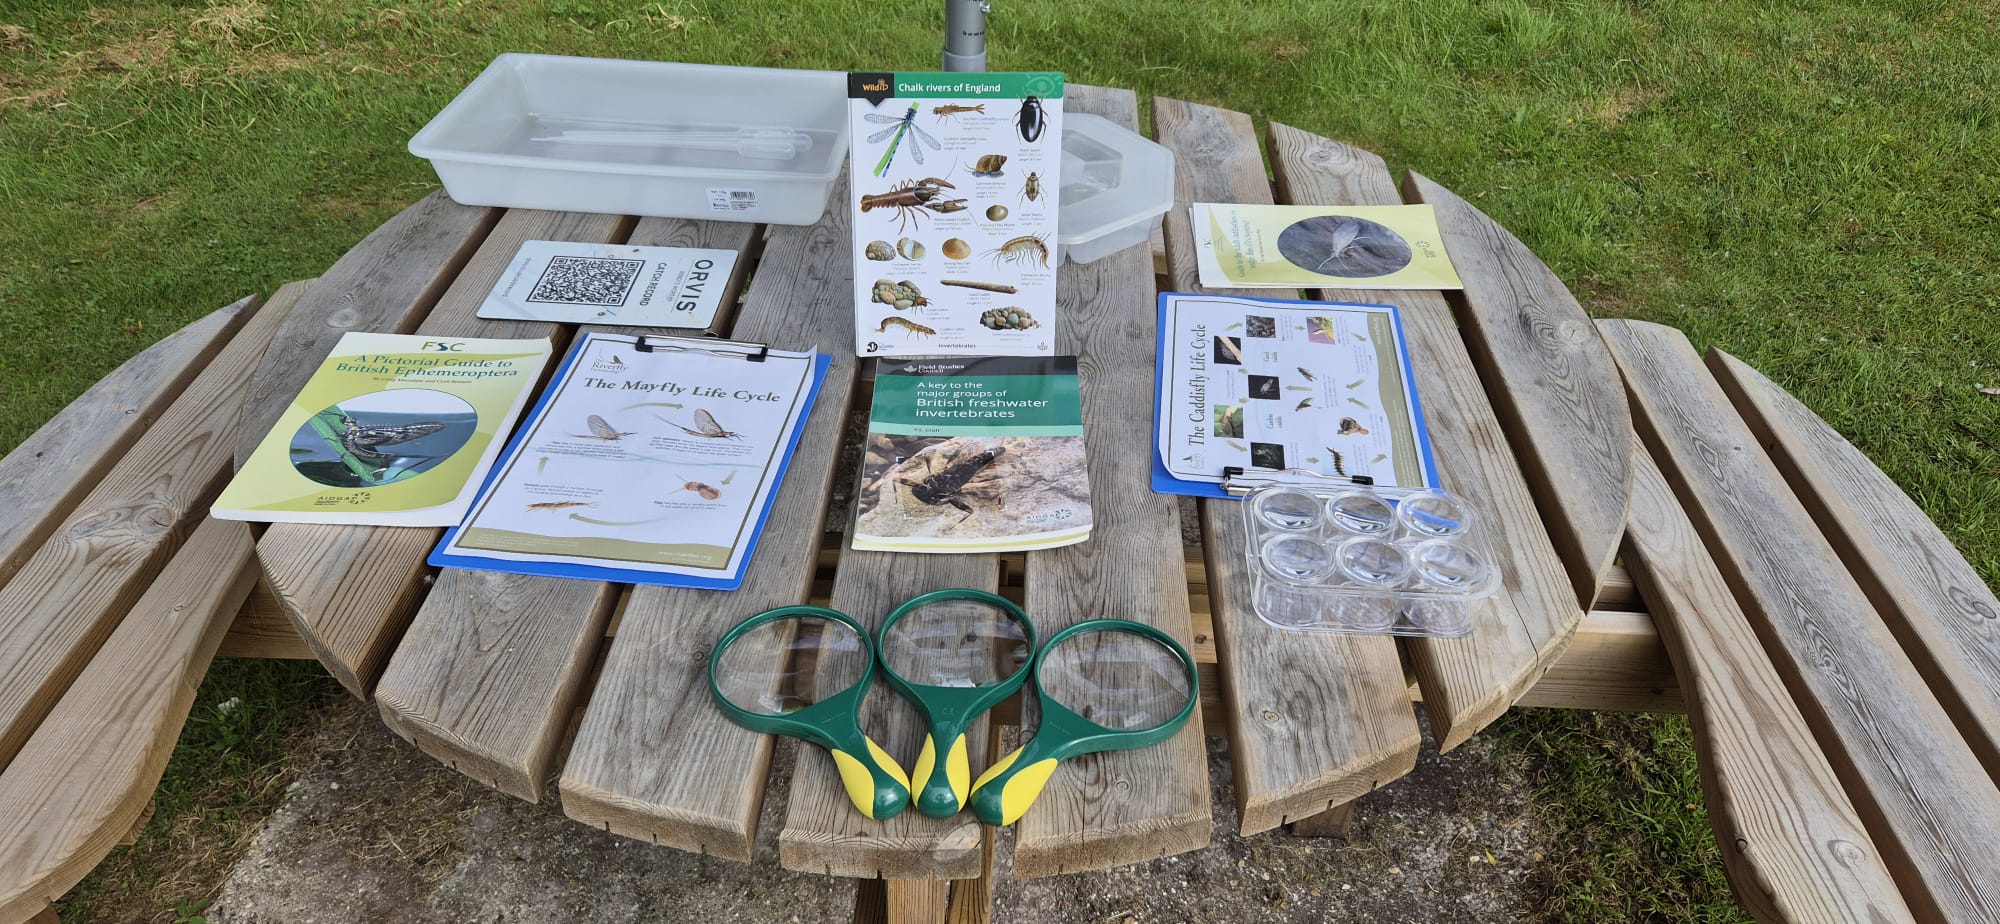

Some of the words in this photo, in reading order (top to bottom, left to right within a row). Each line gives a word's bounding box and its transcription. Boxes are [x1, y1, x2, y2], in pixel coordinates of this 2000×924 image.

[898, 83, 923, 92] Chalk
[926, 83, 951, 92] rivers
[954, 83, 963, 92] of
[965, 83, 1001, 94] England
[650, 263, 667, 281] CATCH
[640, 282, 658, 306] RECORD
[676, 260, 713, 311] ORVIS
[1191, 324, 1210, 349] Cycle
[421, 341, 465, 351] FSC
[374, 355, 439, 366] Pictorial
[443, 358, 493, 367] Guide
[1190, 352, 1205, 371] Life
[336, 363, 389, 374] British
[395, 366, 518, 379] Ephemeroptera
[584, 377, 616, 390] The
[622, 380, 686, 396] Mayfly
[692, 386, 727, 398] Life
[733, 390, 781, 402] Cycle
[1189, 373, 1209, 422] Caddisfly
[917, 398, 963, 407] British
[969, 399, 1048, 408] freshwater
[916, 409, 1015, 418] invertebrates
[1188, 426, 1205, 446] The
